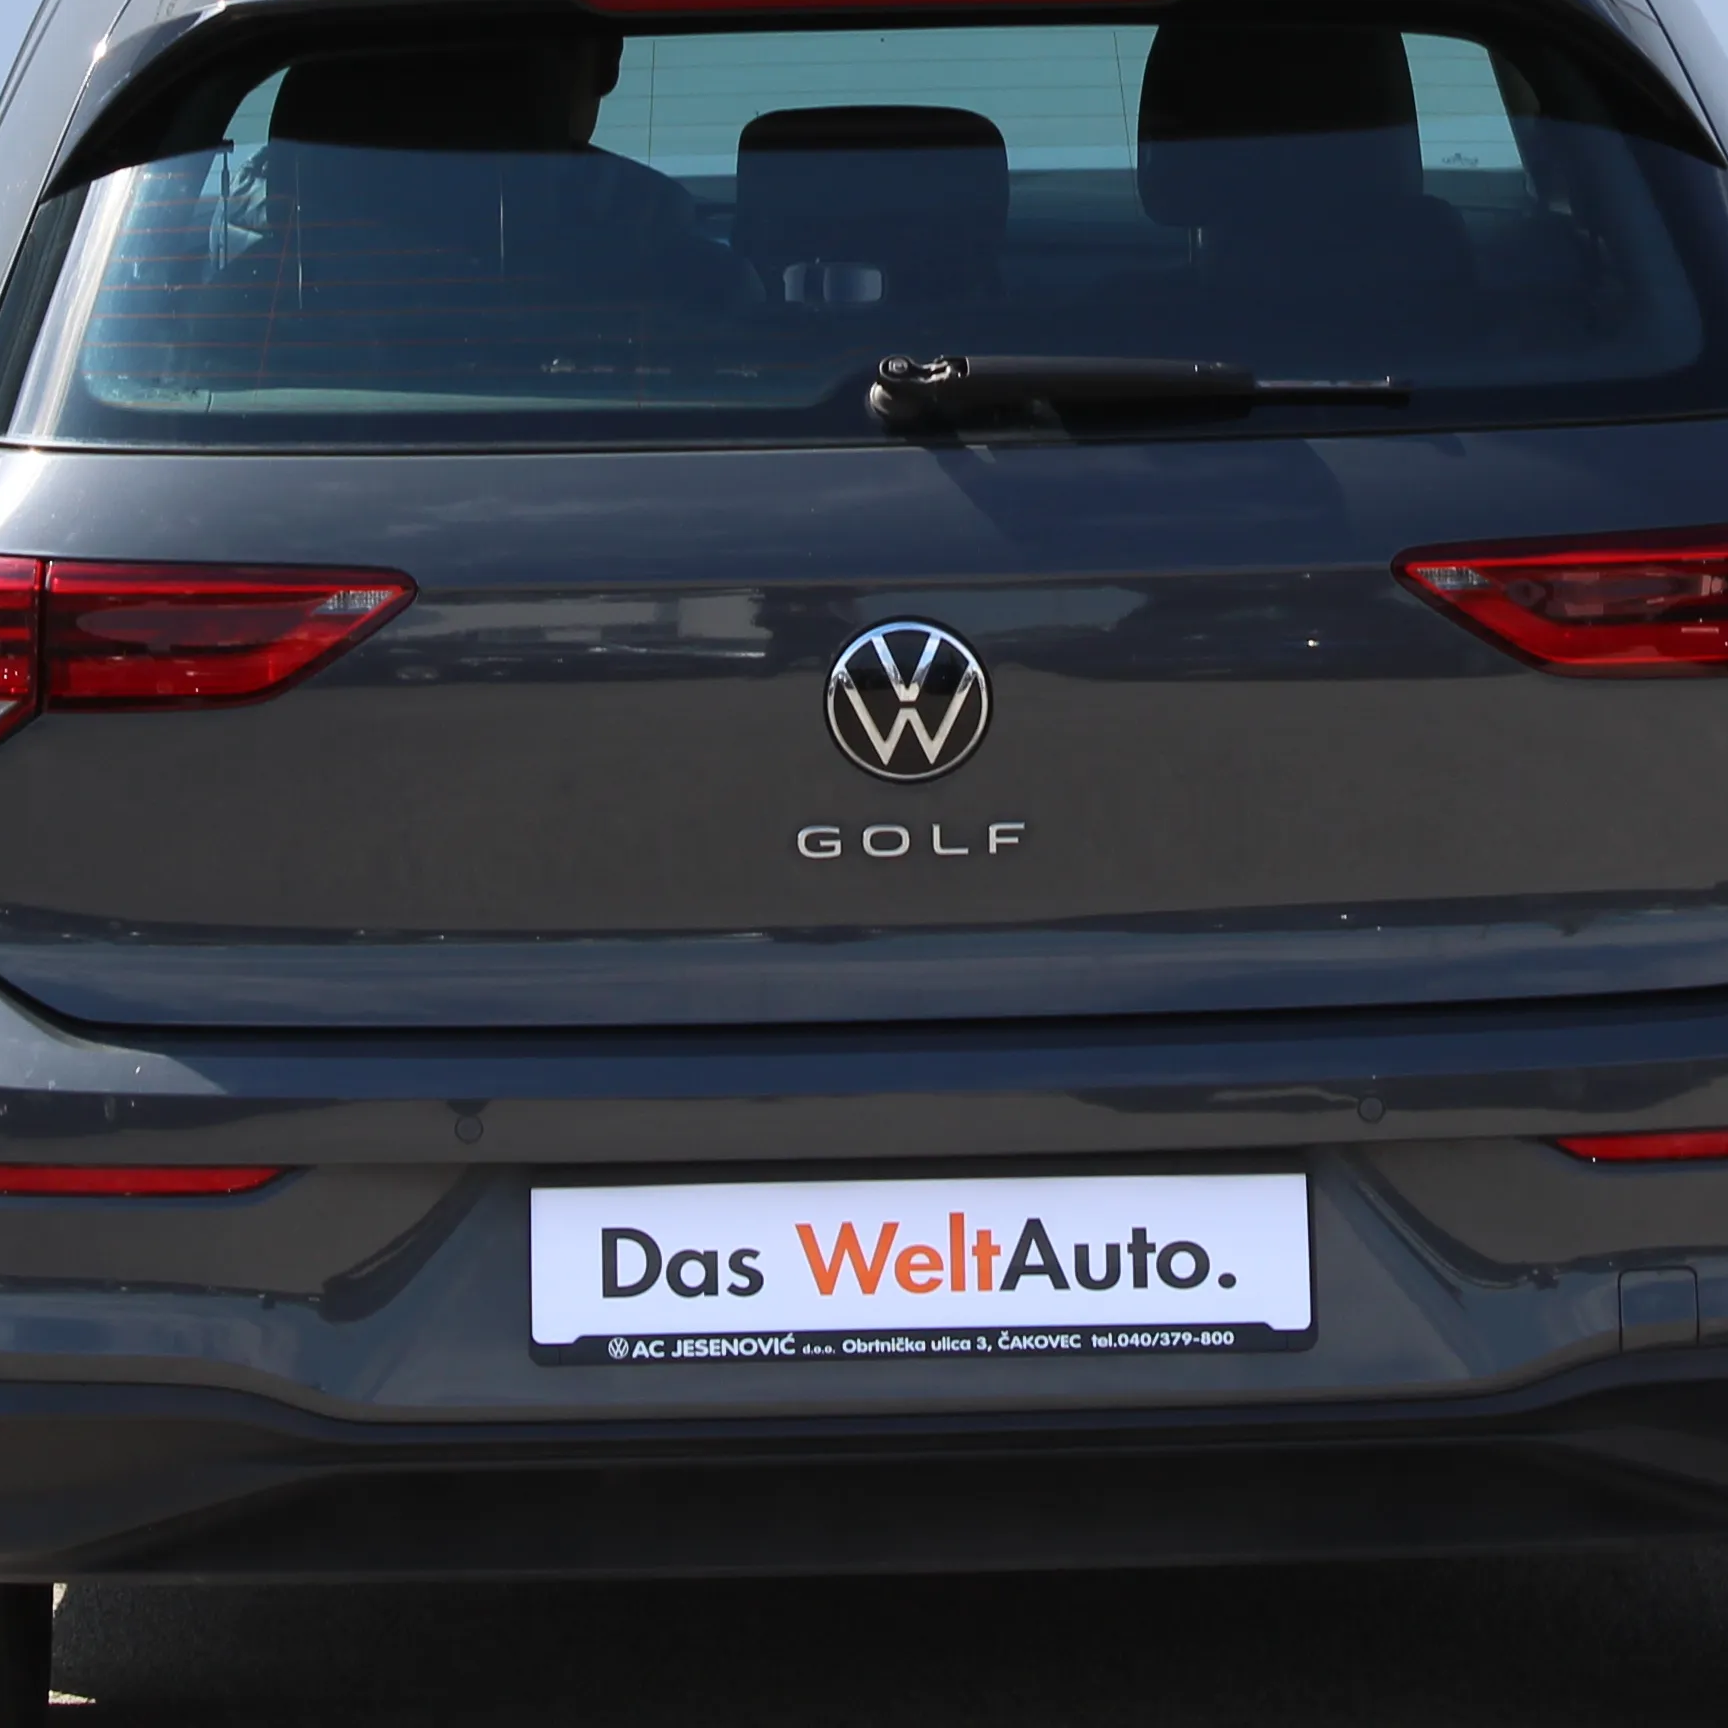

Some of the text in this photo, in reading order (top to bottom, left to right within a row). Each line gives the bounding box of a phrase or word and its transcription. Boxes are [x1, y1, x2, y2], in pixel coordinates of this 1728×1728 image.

[797, 822, 1025, 859] GOLF
[601, 1212, 1237, 1299] Das WeltAuto.
[631, 1340, 665, 1359] AC
[671, 1332, 796, 1358] JESENOVIĆ
[802, 1343, 836, 1355] d.o.o.
[842, 1337, 926, 1353] Obrtnička
[931, 1336, 971, 1352] ulica
[976, 1336, 993, 1352] 3,
[997, 1330, 1082, 1350] ČAKOVEC
[1091, 1331, 1235, 1348] tel.040/379-800
